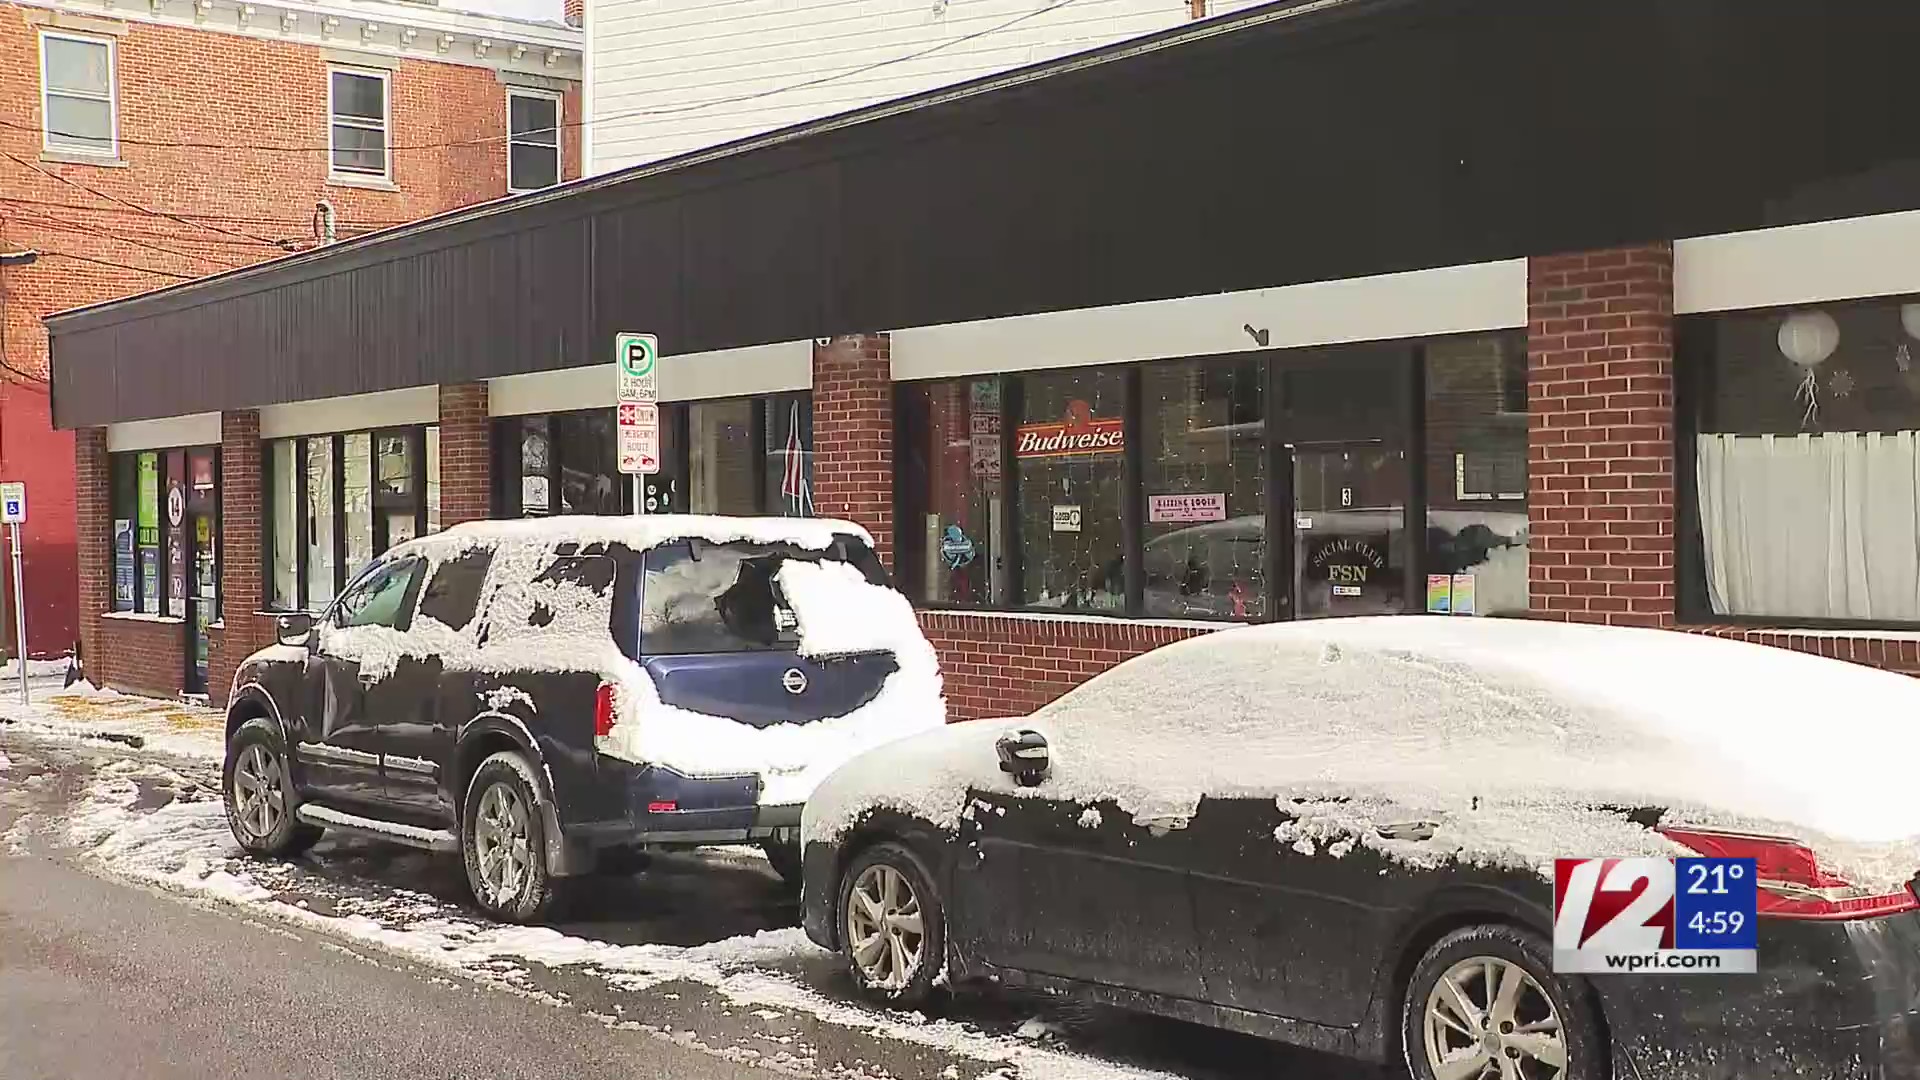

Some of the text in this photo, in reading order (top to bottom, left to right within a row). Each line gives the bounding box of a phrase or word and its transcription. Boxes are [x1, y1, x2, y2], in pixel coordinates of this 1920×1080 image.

[629, 345, 645, 369] P
[624, 379, 652, 389] 2 HOUR
[627, 442, 649, 452] ROUTE
[1019, 427, 1124, 453] Budweise
[1344, 490, 1349, 504] 3
[1313, 539, 1384, 568] SOCIAL CLUB
[1328, 565, 1368, 583] FSN
